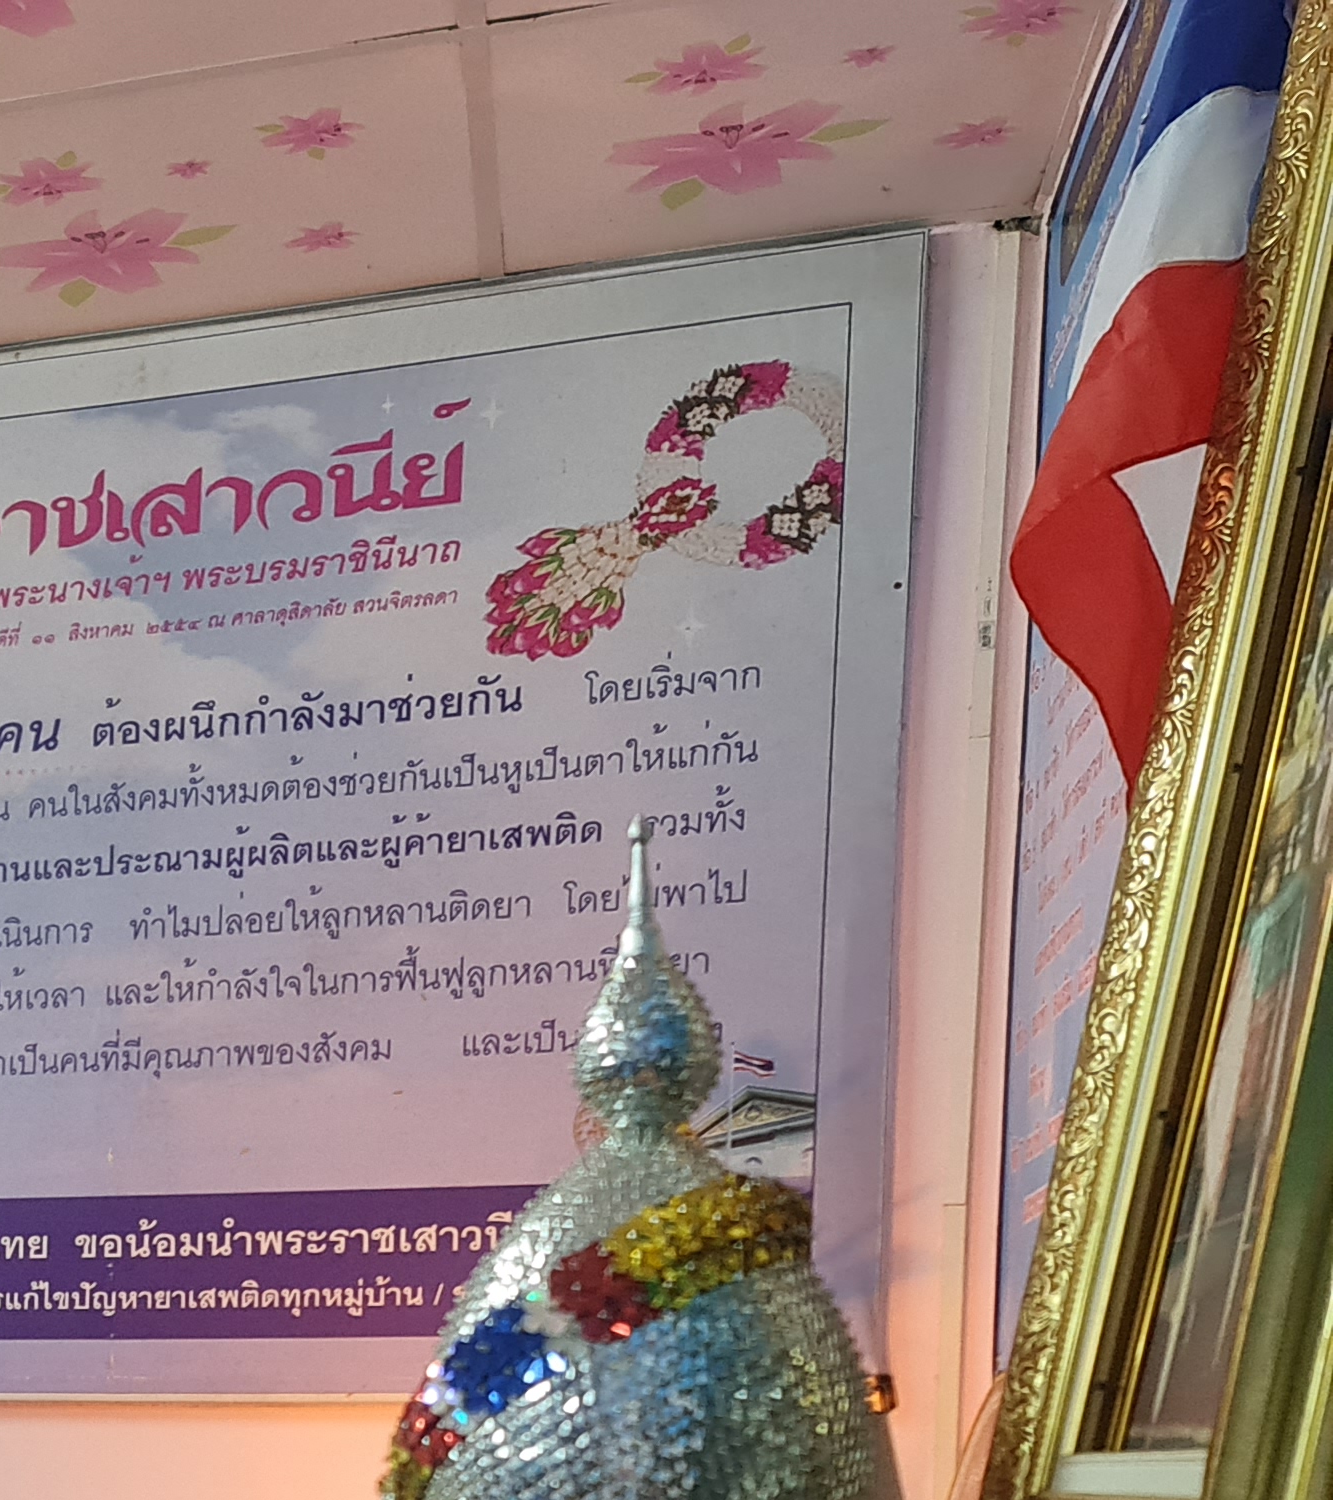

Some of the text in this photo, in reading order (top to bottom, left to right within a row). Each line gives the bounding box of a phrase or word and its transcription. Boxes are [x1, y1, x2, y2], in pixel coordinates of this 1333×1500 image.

[182, 535, 462, 591] พระบรมราชินีนาถ
[31, 632, 56, 646] ๑๑
[68, 621, 134, 642] สิงหาคม
[146, 617, 203, 635] ๒๕๕๔
[207, 613, 226, 629] ณ
[353, 588, 459, 616] สวนจิตรลดา
[92, 672, 523, 749] ต้องผนึกกำลังมาช่วยกัน
[585, 652, 762, 707] โดยเริ่มจาก
[28, 718, 759, 821] คนในสังคมทั้งหมดต้องช่วยกันเป็นหูเป็นตาให้แก่กัน
[130, 884, 533, 941] ทำไมปล่อยให้ลูกหลานติดยา
